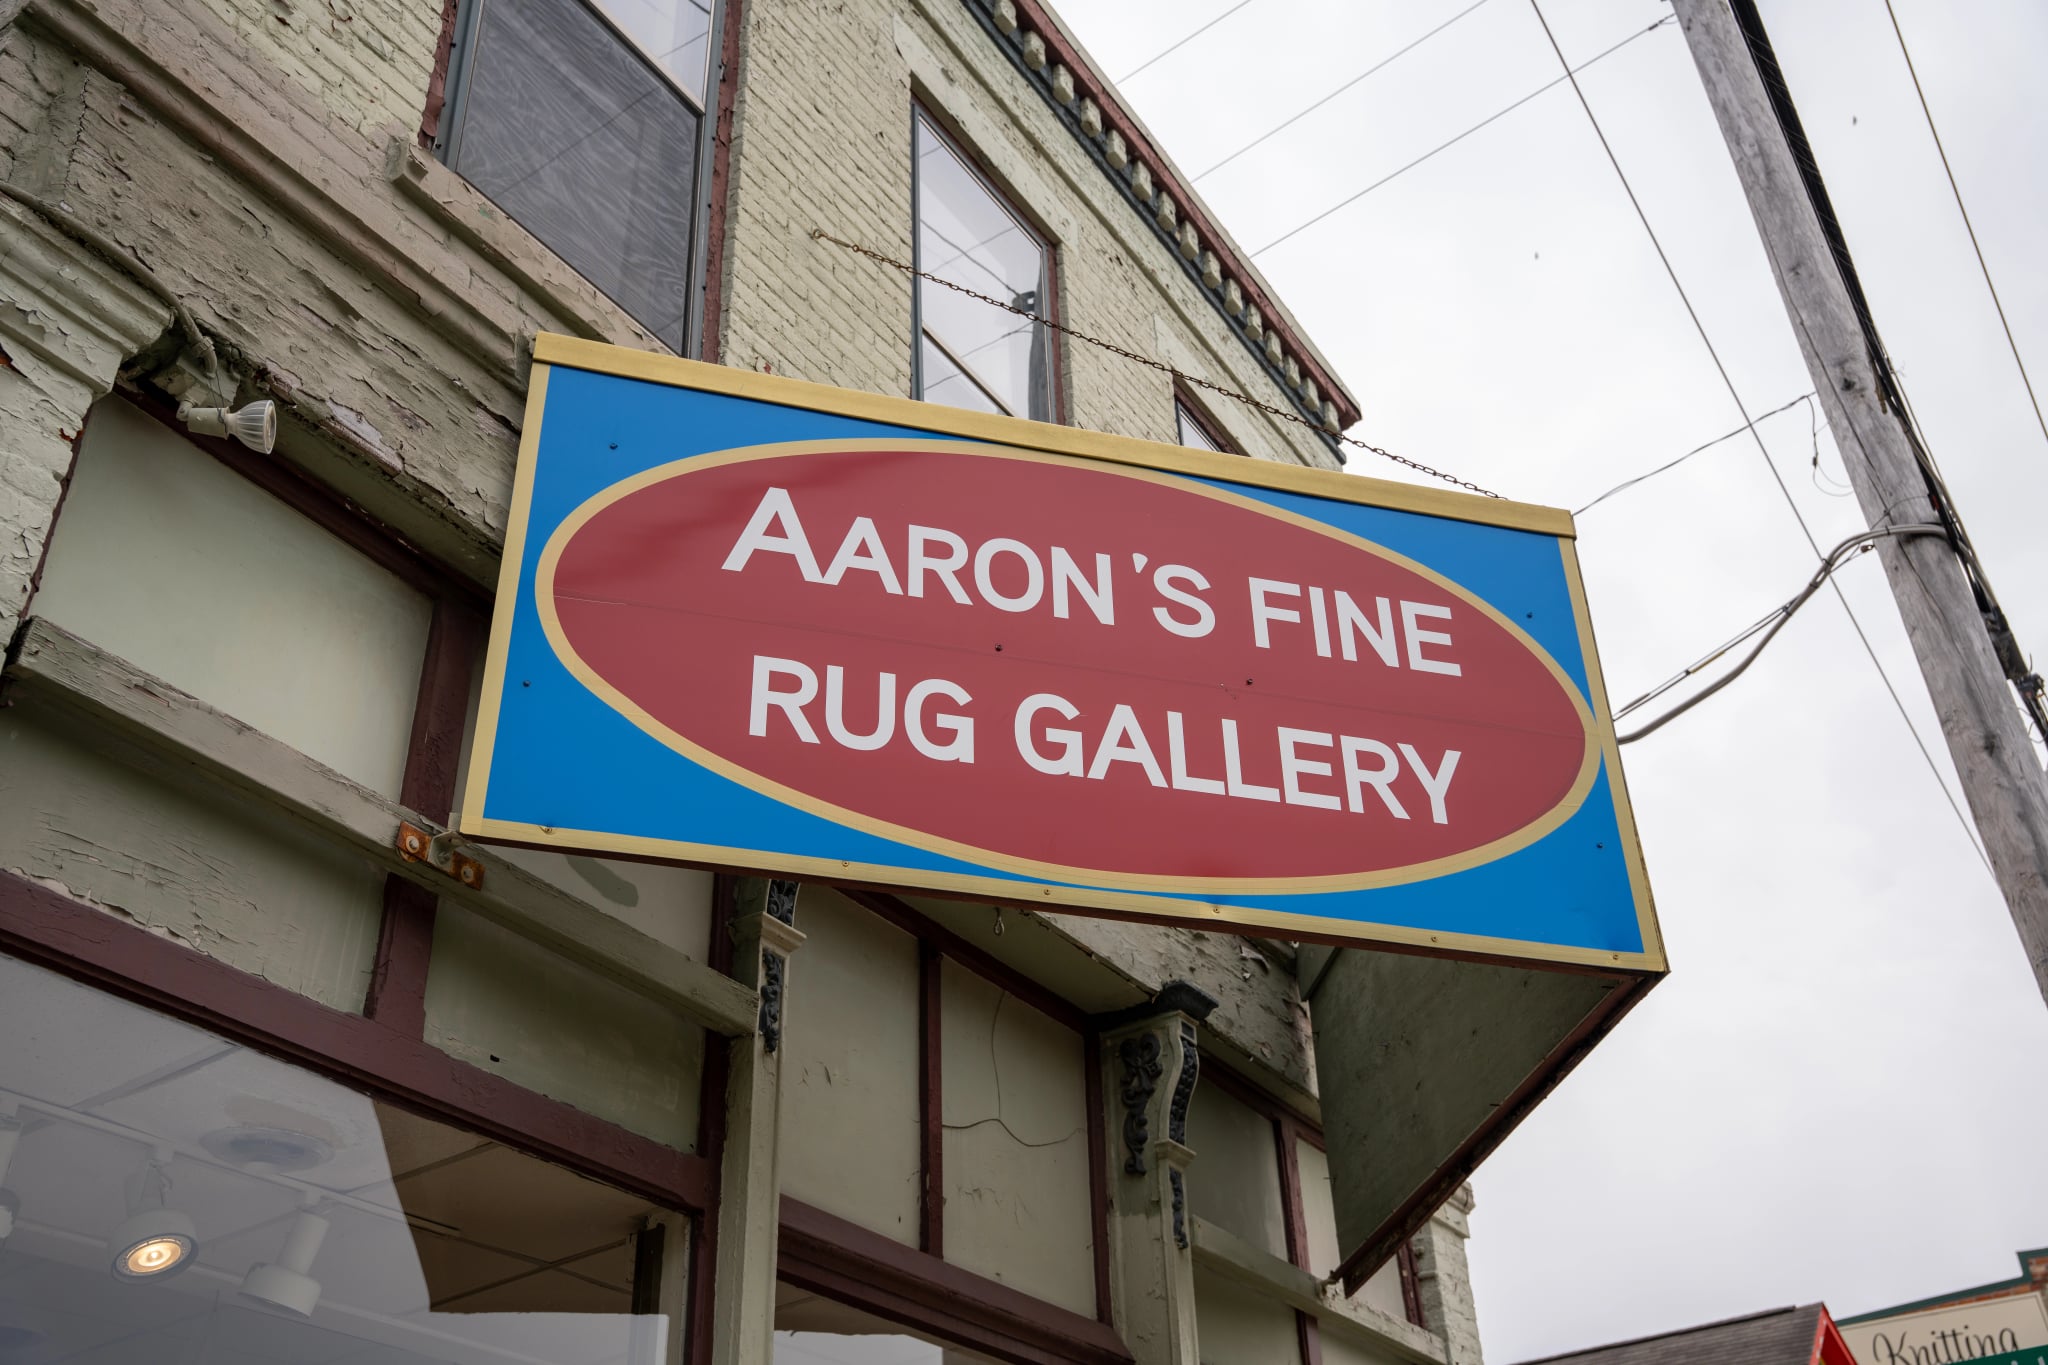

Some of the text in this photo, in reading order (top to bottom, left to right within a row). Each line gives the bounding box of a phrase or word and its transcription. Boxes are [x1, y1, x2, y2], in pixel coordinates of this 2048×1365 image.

[722, 487, 1462, 677] AARON'S FINE
[749, 655, 1462, 825] RUG GALLERY
